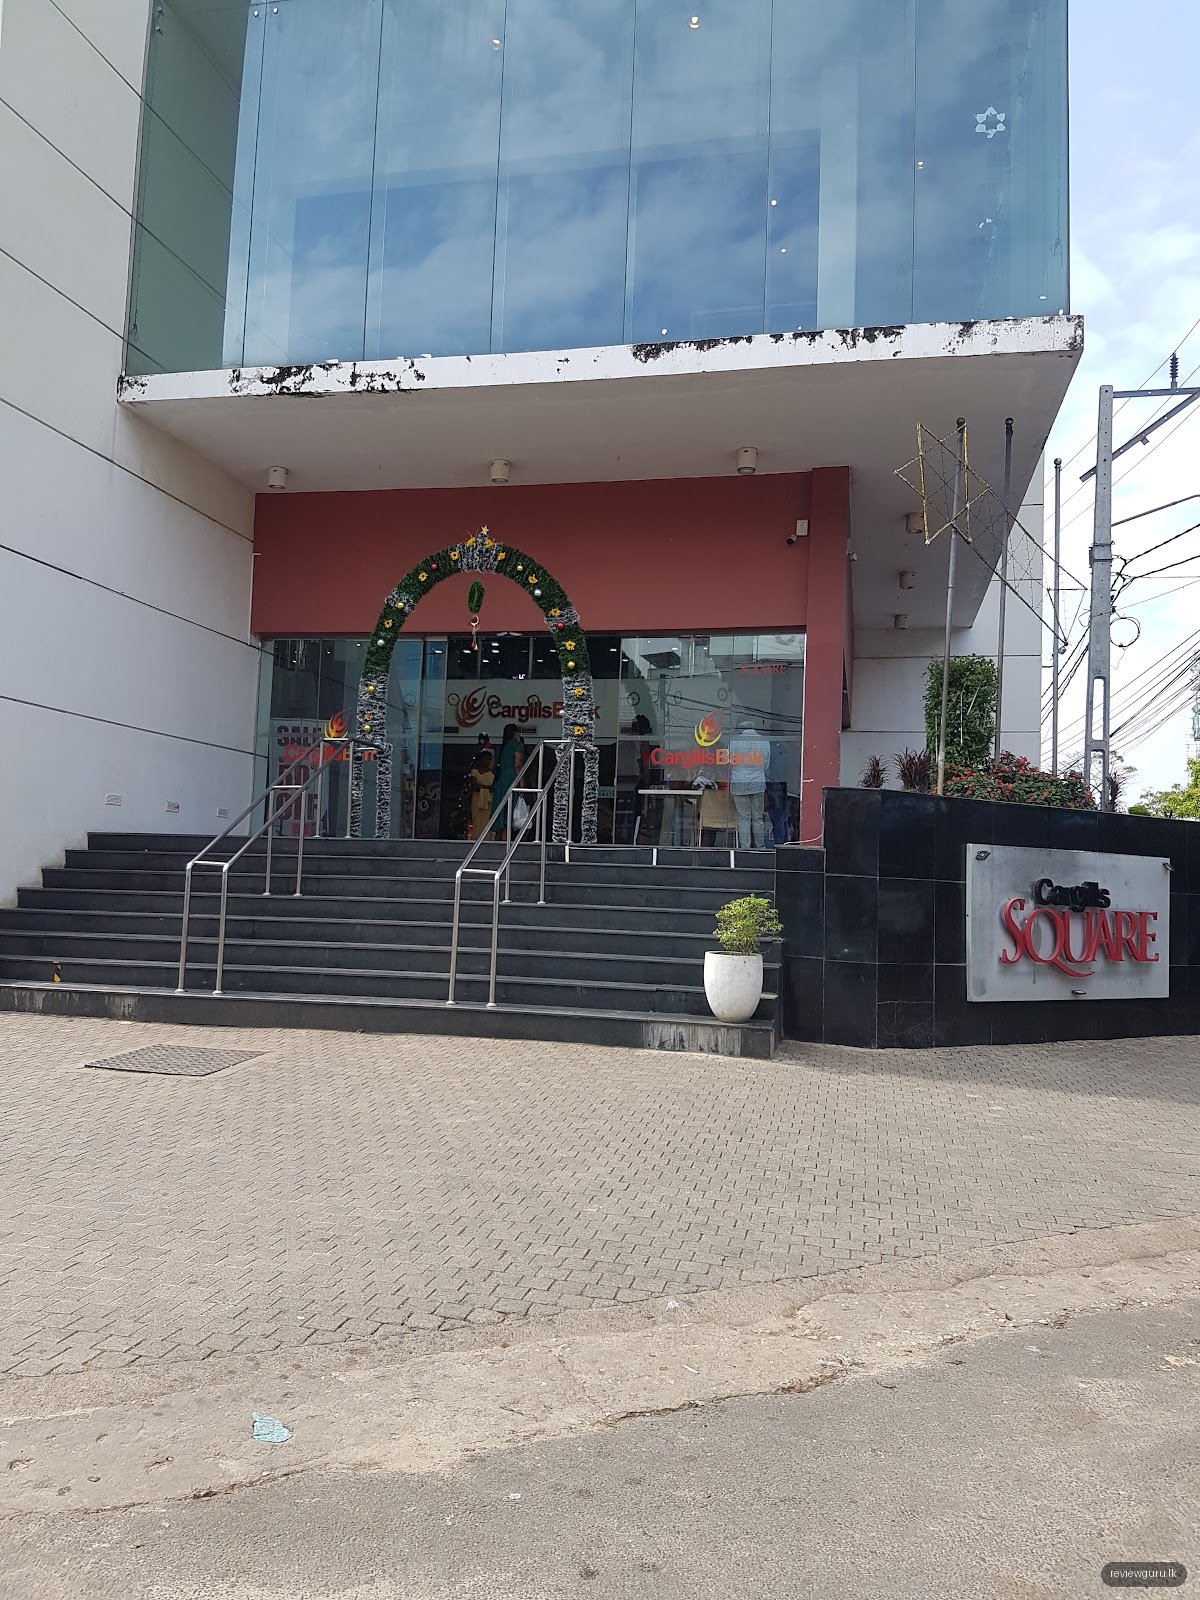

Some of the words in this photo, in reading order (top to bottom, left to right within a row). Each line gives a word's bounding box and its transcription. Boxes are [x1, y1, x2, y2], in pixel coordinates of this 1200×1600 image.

[650, 747, 764, 769] CargillsBank
[1035, 878, 1111, 913] Cargills
[999, 898, 1160, 978] SQUARE
